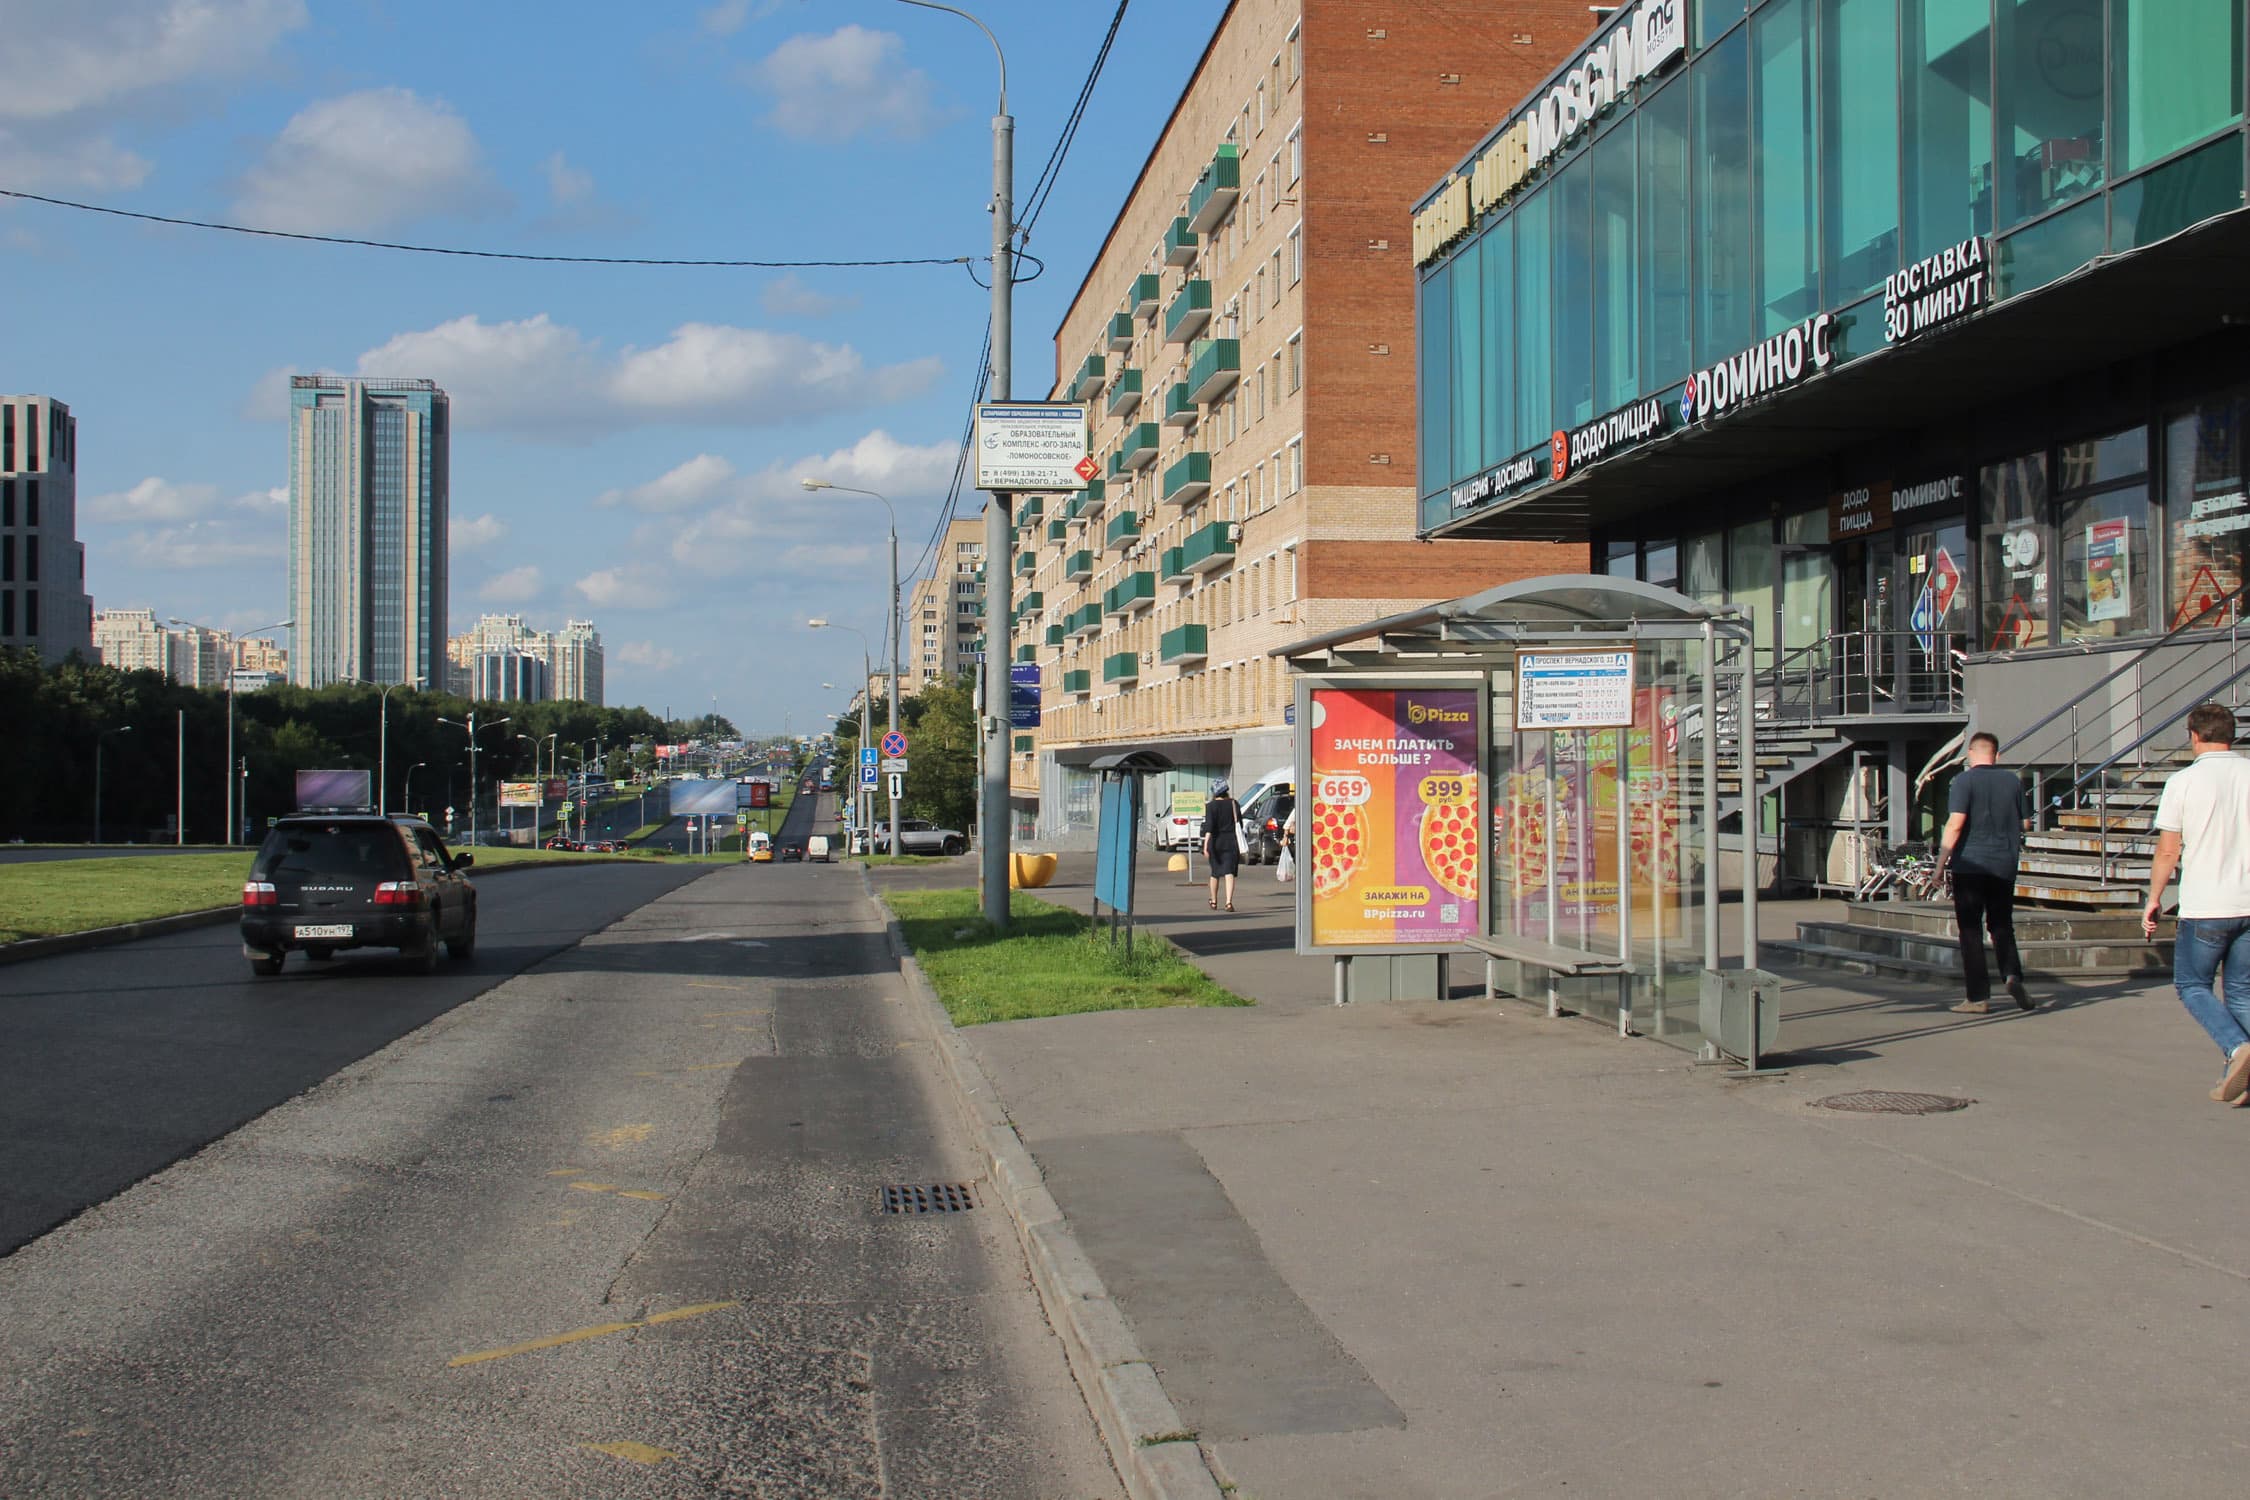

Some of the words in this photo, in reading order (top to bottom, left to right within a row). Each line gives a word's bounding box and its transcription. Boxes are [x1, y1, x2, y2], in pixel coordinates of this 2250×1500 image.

[1527, 10, 1646, 169] MOSGYM
[1884, 236, 1982, 309] ДОСТАВКА
[1884, 303, 1909, 343] 30
[1913, 271, 1984, 330] МИНУТ
[1010, 430, 1076, 438] ОБРАЗОВАТЕЛЬНЫЙ
[1571, 422, 1607, 466] ДОДО
[1609, 399, 1660, 445] ПИЦЦА
[1002, 440, 1039, 448] КОМПЛЕКС
[1451, 476, 1489, 510] ПИЦЦЕРИЯ
[1494, 457, 1534, 495] ДОСТАВКА
[1842, 488, 1869, 510] ДОДО
[1840, 511, 1873, 532] ПИЦЦА
[1535, 656, 1564, 665] ПРОСПЕКТ
[1428, 708, 1469, 722] Pizza
[1334, 739, 1383, 751] ЗАЧЕМ
[1386, 739, 1454, 751] ПЛАТИТЬ
[1426, 781, 1462, 797] 399
[1365, 891, 1408, 900] ЗАКАЖИ
[1410, 891, 1425, 900] НА
[1363, 909, 1425, 920] BPpizza.ru
